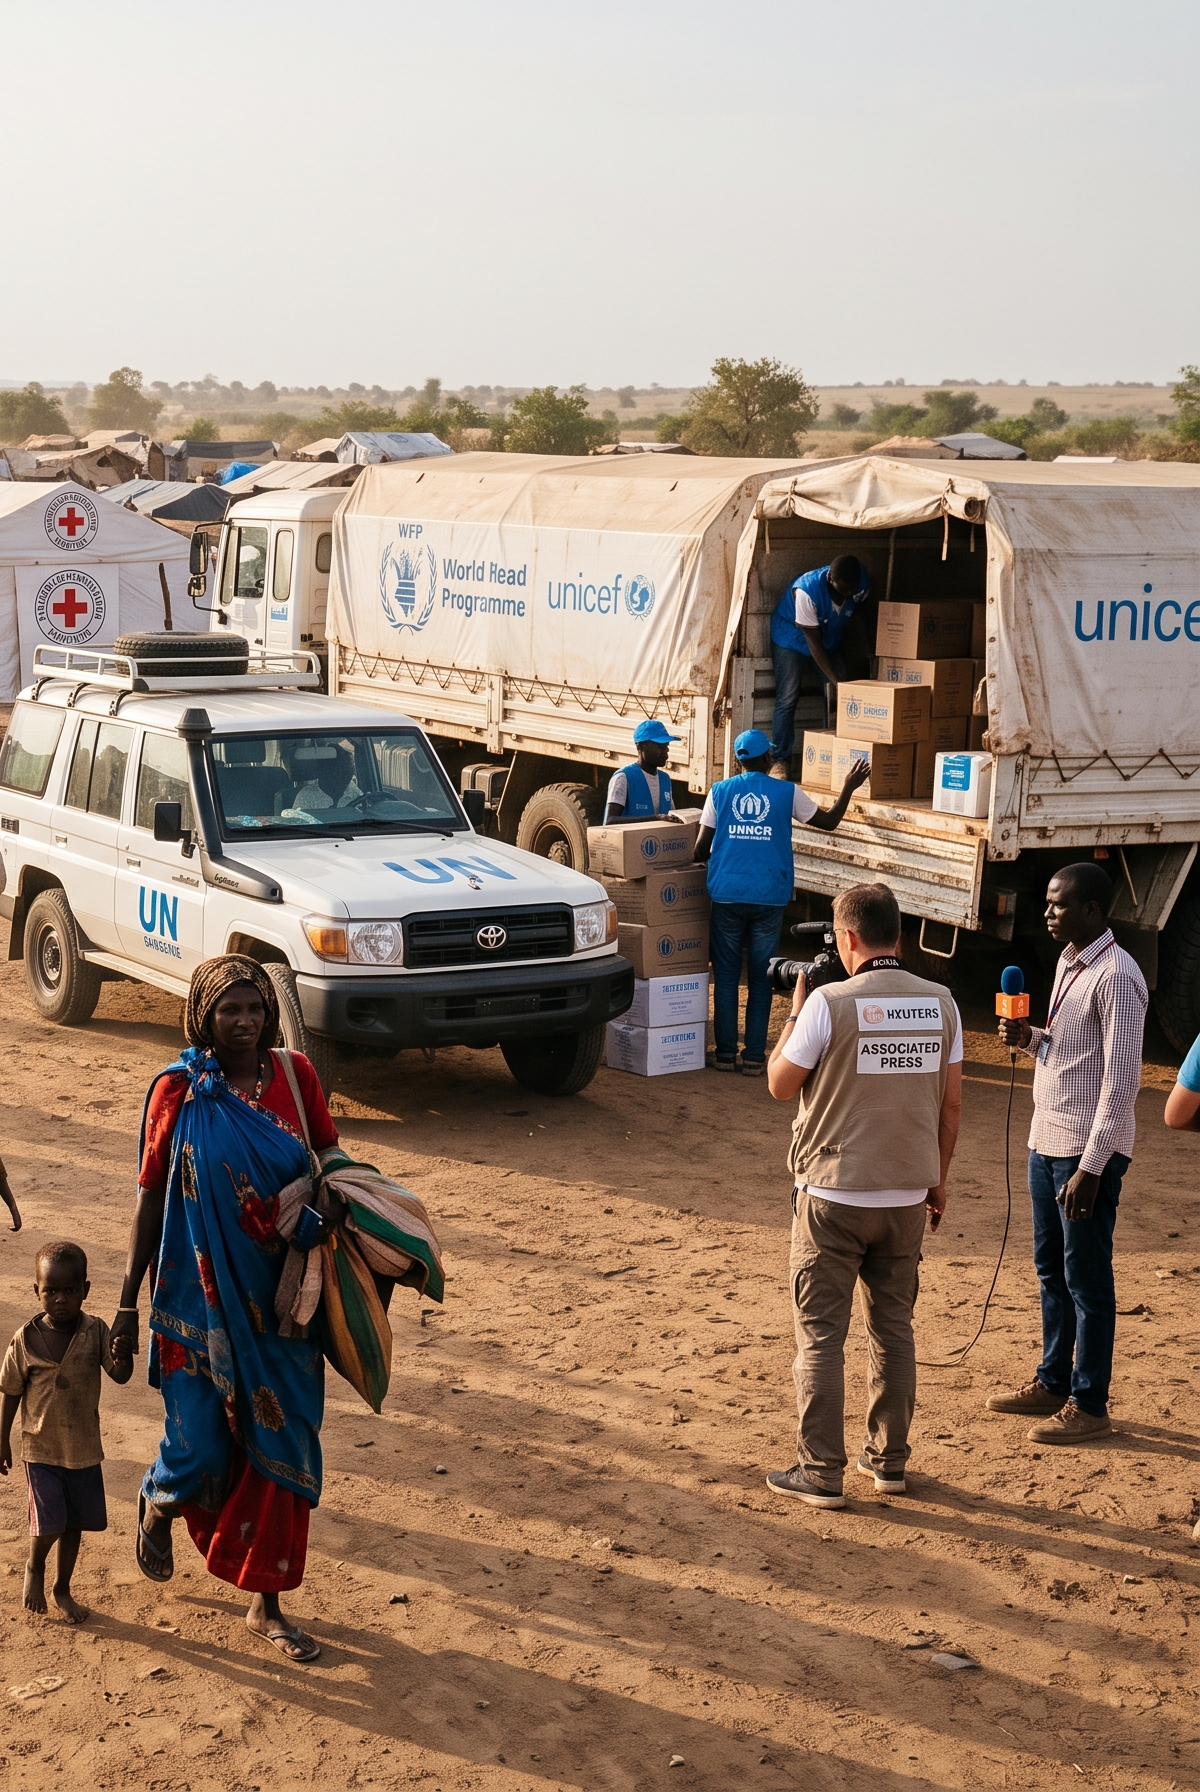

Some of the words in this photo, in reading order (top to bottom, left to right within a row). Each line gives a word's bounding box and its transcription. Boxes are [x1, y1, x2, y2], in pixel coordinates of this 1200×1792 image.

[398, 523, 423, 539] WFP
[443, 558, 485, 582] World
[442, 587, 526, 617] Programme
[548, 572, 623, 614] unicef
[1074, 582, 1200, 642] unice
[382, 855, 518, 884] UN
[139, 885, 179, 942] UN
[860, 1042, 940, 1055] ASSOCIATED
[880, 1056, 923, 1068] PRESS
